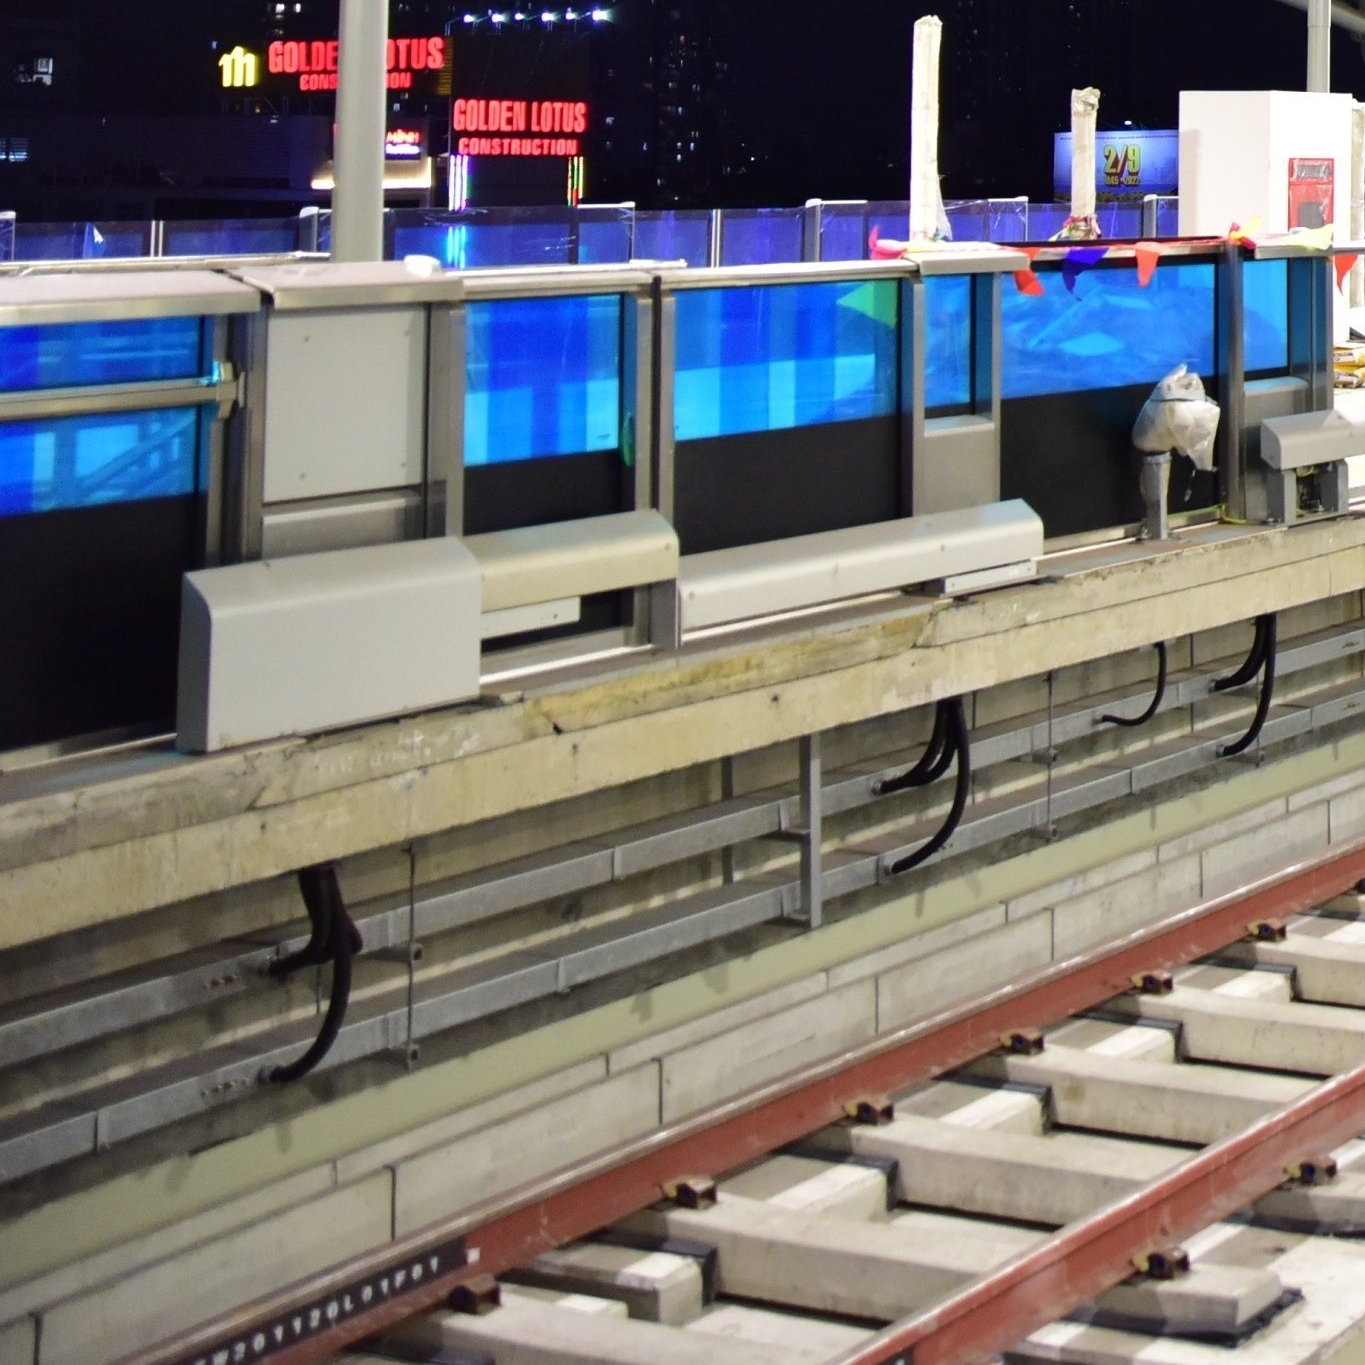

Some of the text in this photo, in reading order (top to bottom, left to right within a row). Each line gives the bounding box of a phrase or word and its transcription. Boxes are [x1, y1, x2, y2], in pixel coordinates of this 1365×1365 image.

[268, 37, 445, 73] GOLDE OTUS
[453, 99, 586, 133] GOLDEN LOTUS
[458, 137, 577, 156] CONSTRUCTION
[1104, 144, 1141, 174] 2/9
